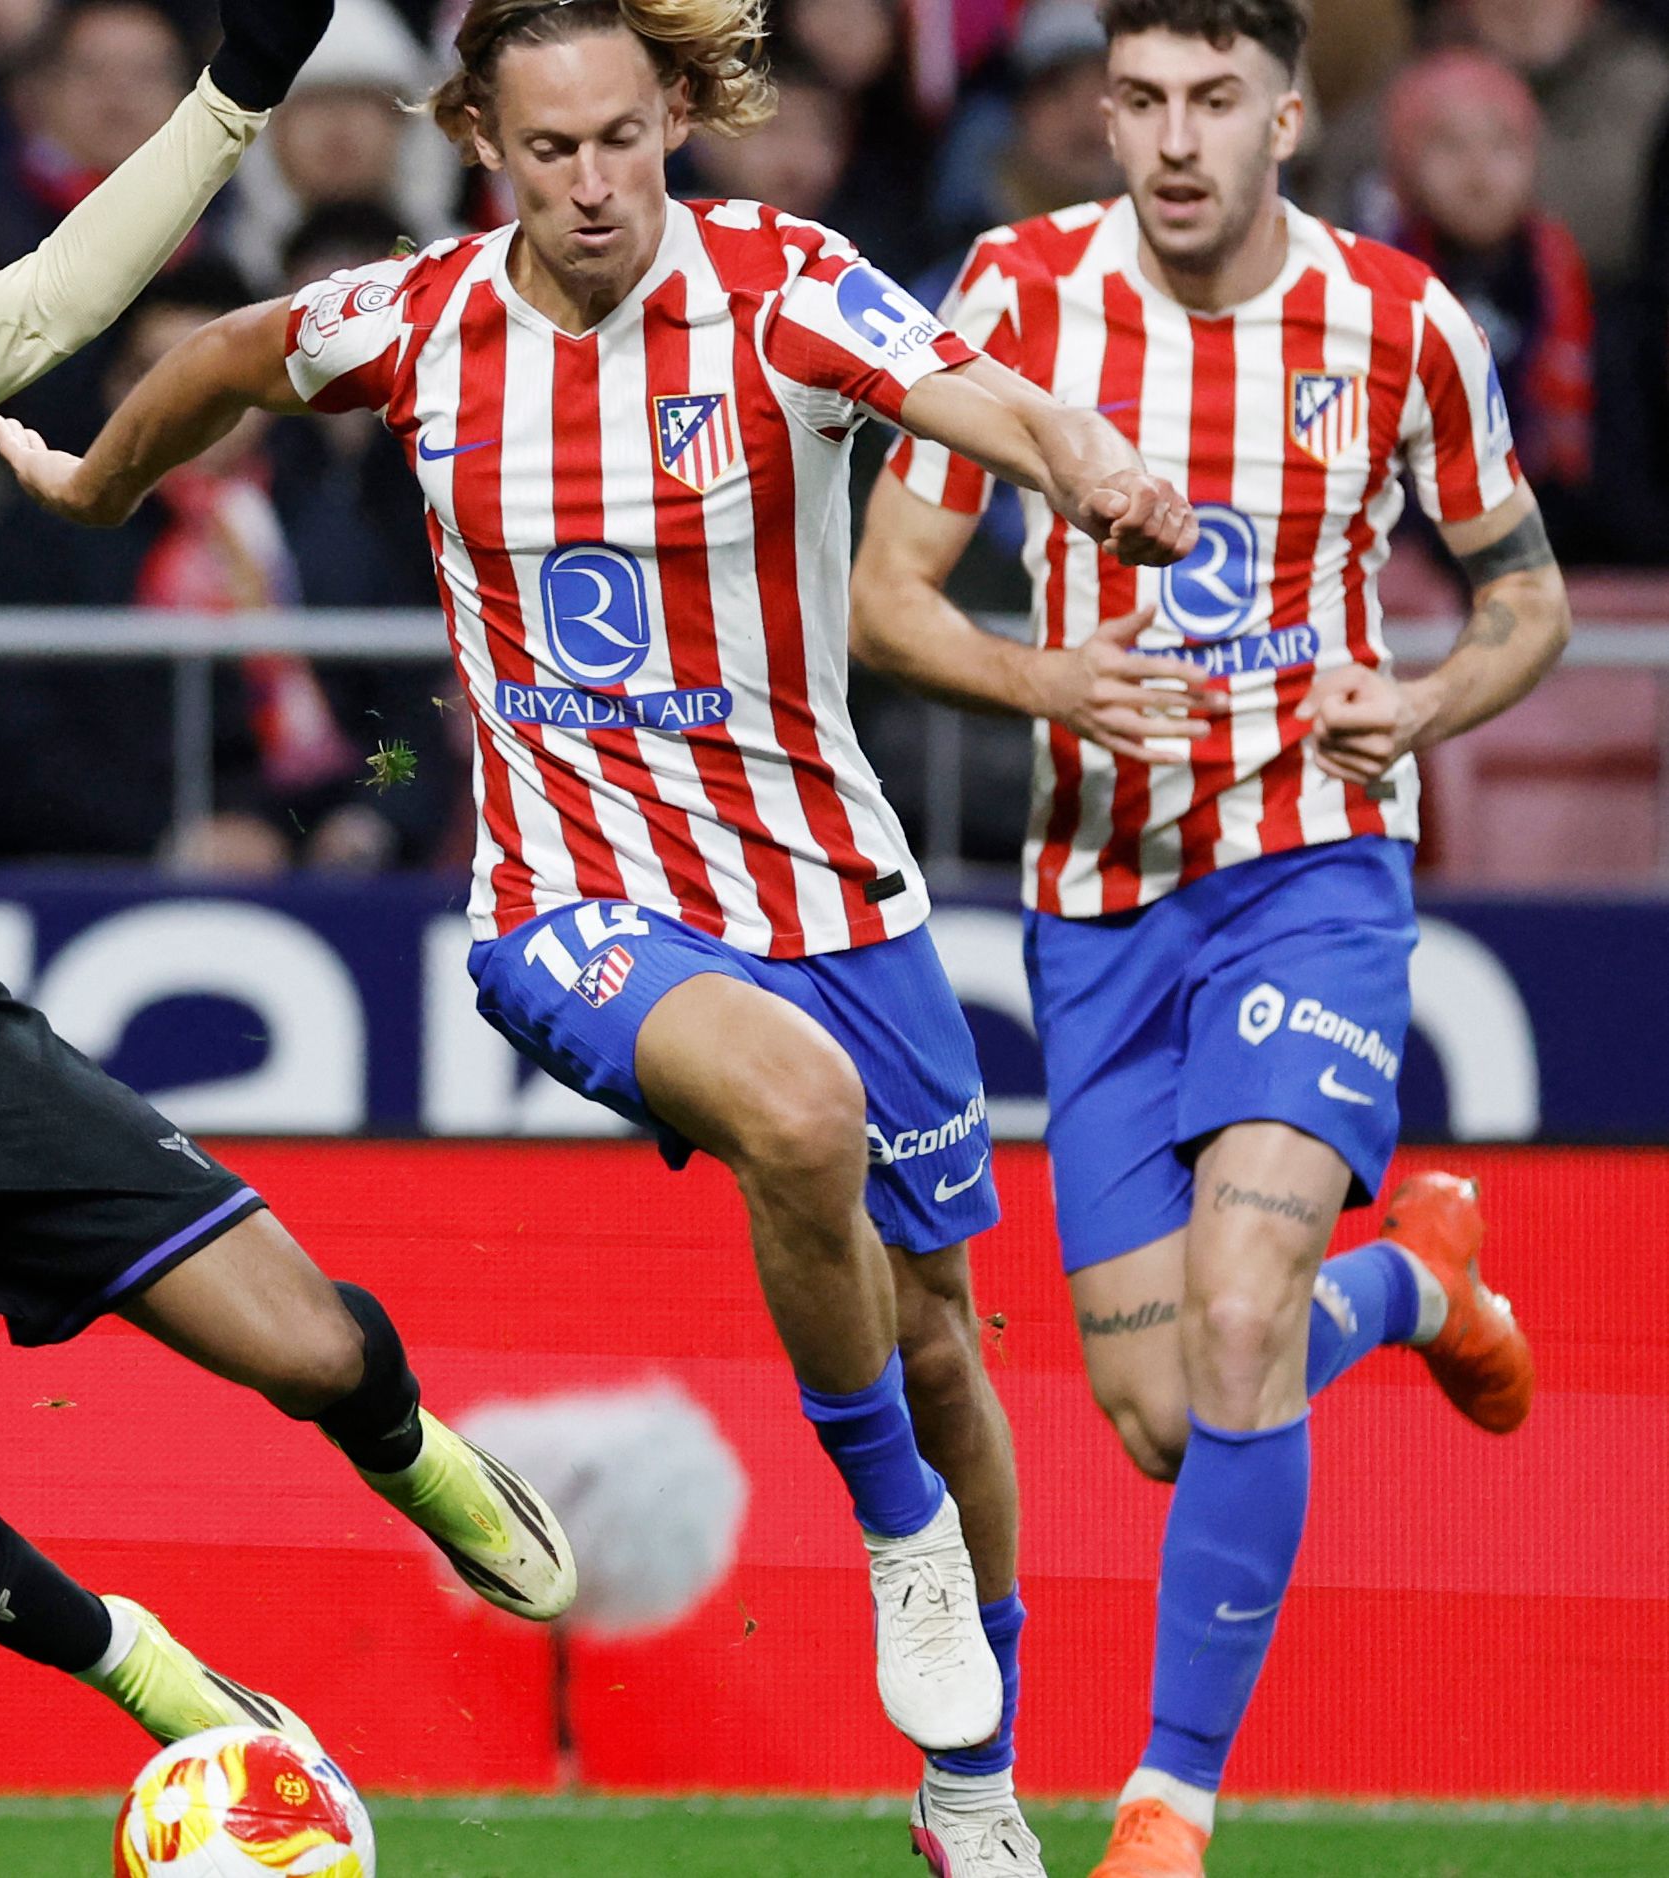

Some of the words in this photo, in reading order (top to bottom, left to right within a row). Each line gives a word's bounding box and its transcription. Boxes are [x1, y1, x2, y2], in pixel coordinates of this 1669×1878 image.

[1253, 624, 1315, 671] AIR
[504, 684, 646, 725] RIYADH
[658, 691, 724, 727] AIR
[523, 901, 650, 992] 14
